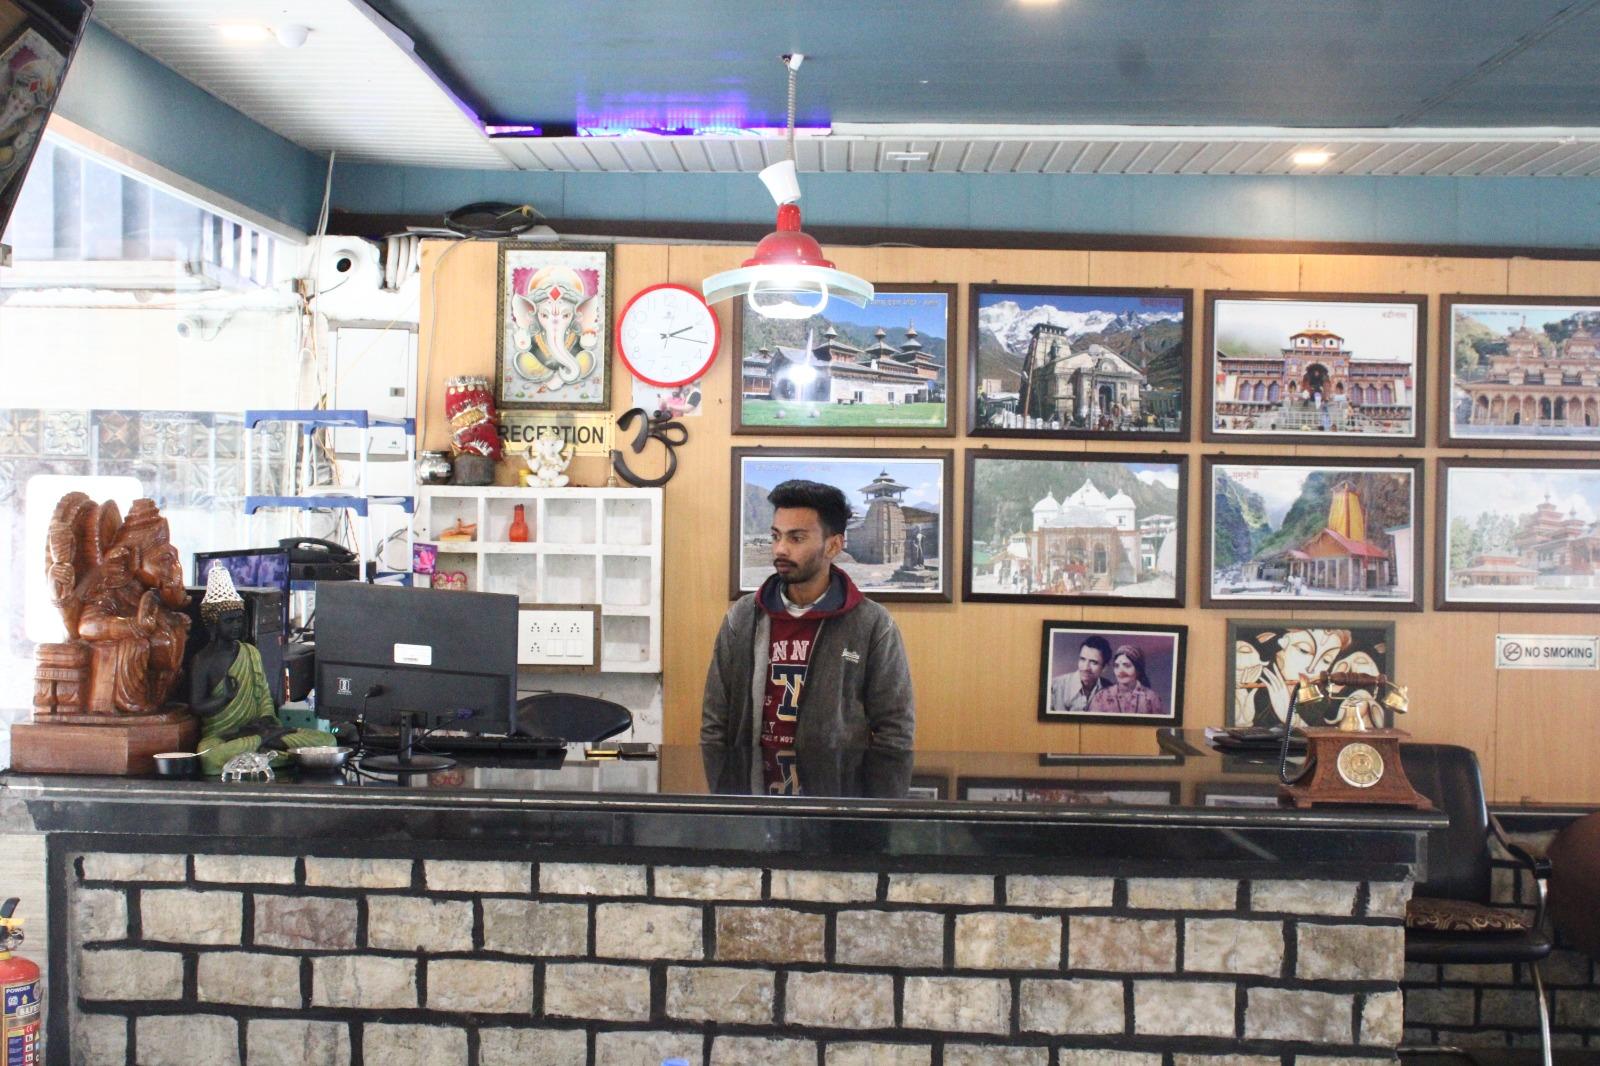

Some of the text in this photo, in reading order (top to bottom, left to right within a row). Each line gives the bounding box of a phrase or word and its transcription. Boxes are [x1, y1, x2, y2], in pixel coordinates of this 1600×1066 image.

[769, 640, 810, 663] NN
[1525, 647, 1593, 658] NO SMOKING
